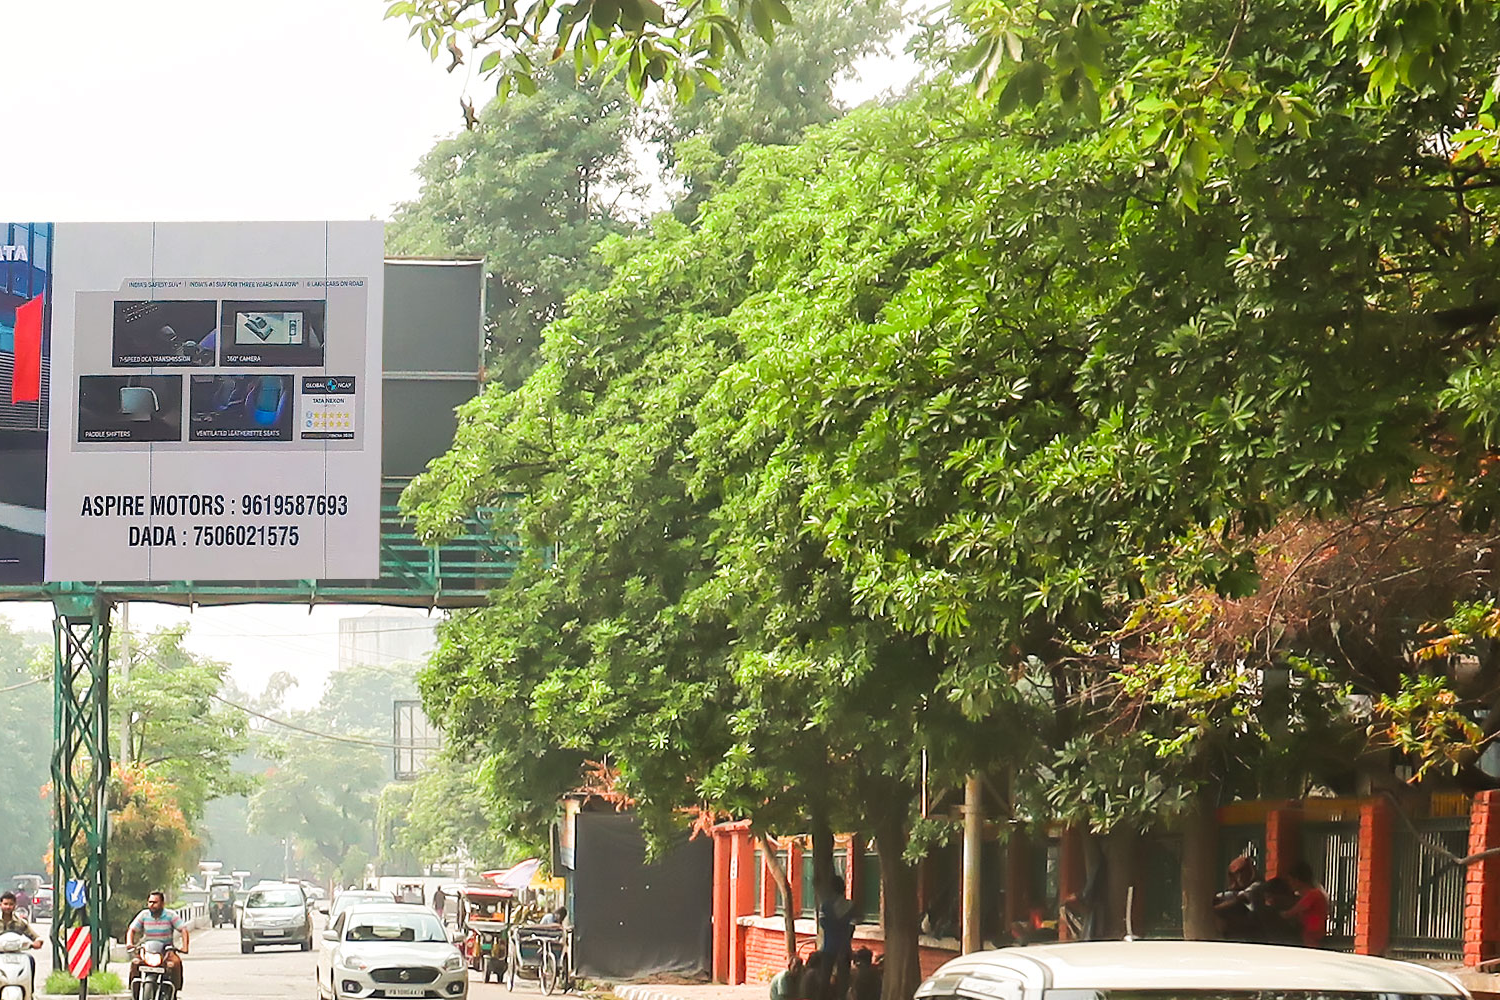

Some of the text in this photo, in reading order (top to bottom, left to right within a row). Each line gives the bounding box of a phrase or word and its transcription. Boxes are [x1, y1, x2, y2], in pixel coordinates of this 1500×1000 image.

[85, 430, 130, 438] PADDLE SHIFTERS
[81, 495, 144, 516] ASPIRE
[151, 495, 225, 516] MOTORS
[242, 494, 348, 516] 9619587693
[129, 526, 176, 547] DADA
[193, 525, 299, 546] 7506021575
